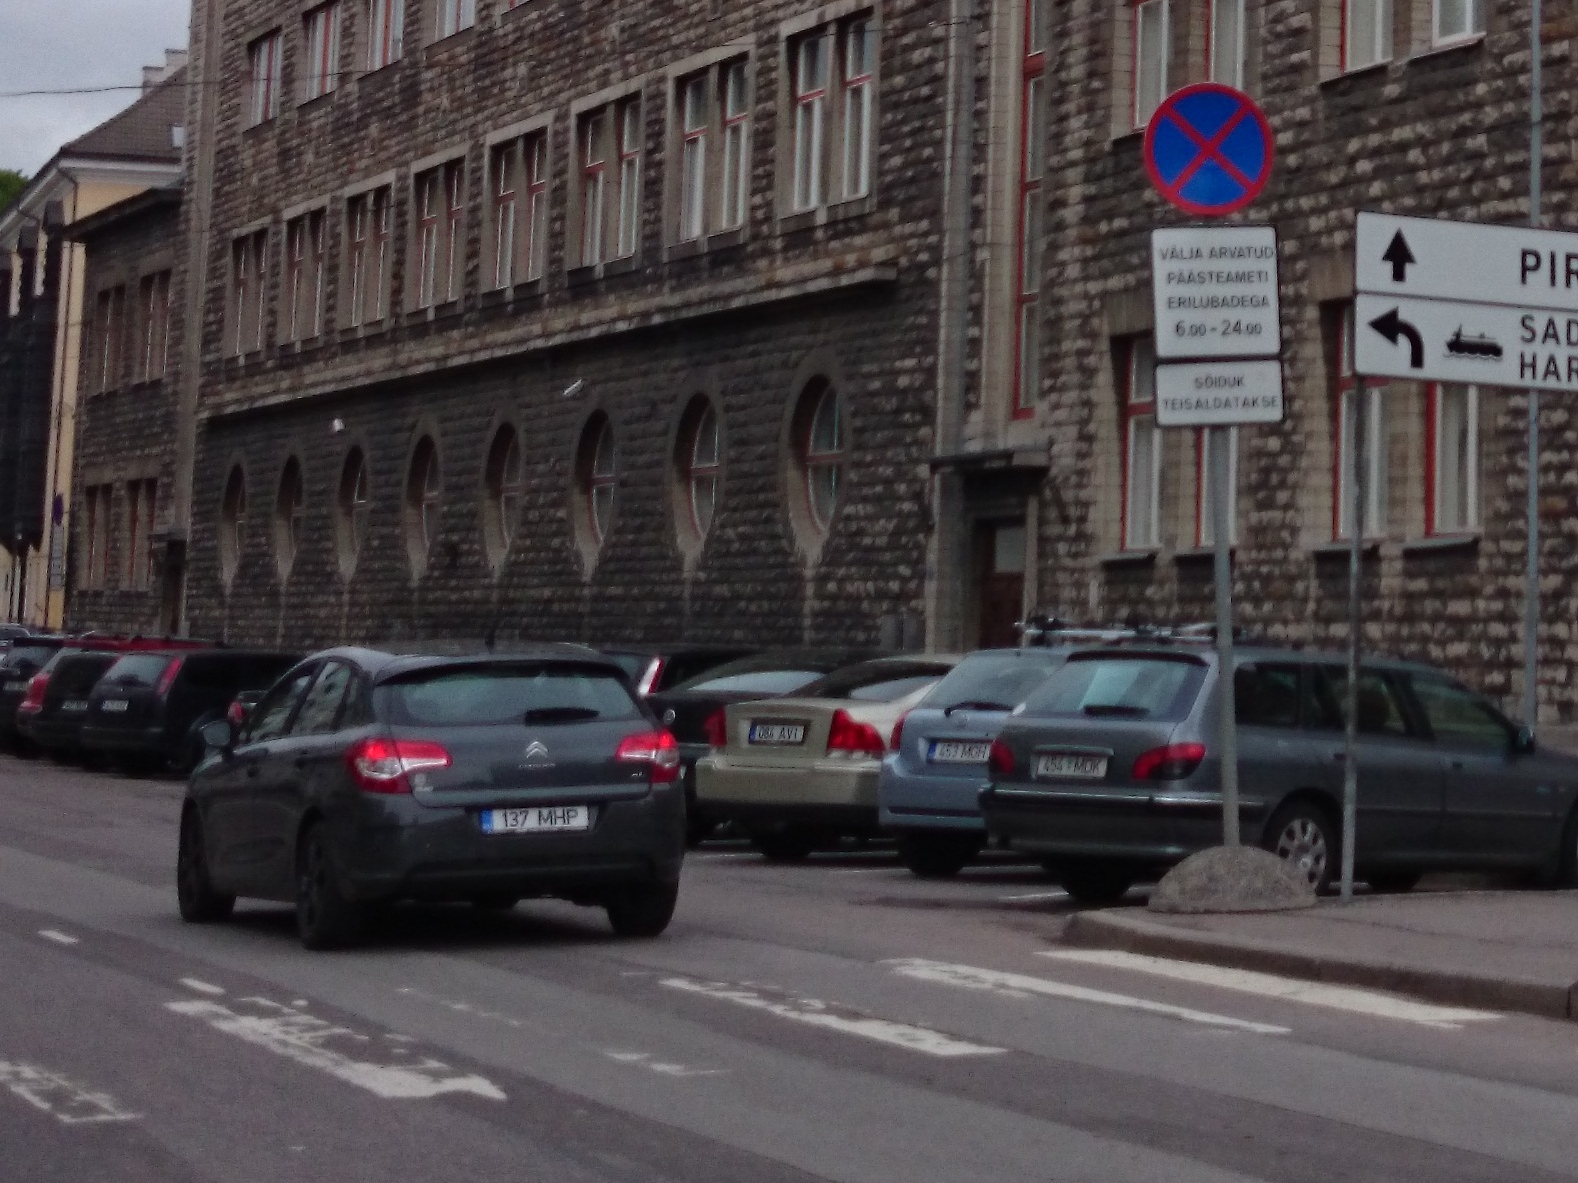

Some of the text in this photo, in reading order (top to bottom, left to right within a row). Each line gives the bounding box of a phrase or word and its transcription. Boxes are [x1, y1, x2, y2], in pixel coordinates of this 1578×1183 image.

[1160, 244, 1275, 259] VÄLJA ARVATUD
[1167, 269, 1269, 284] PÄÄSTEAMETI
[1167, 294, 1270, 309] ERILUBADEGA
[1194, 373, 1245, 388] SÕIDUK
[1162, 395, 1279, 411] TEISALDATAKSE
[502, 806, 580, 828] 137 MHP
